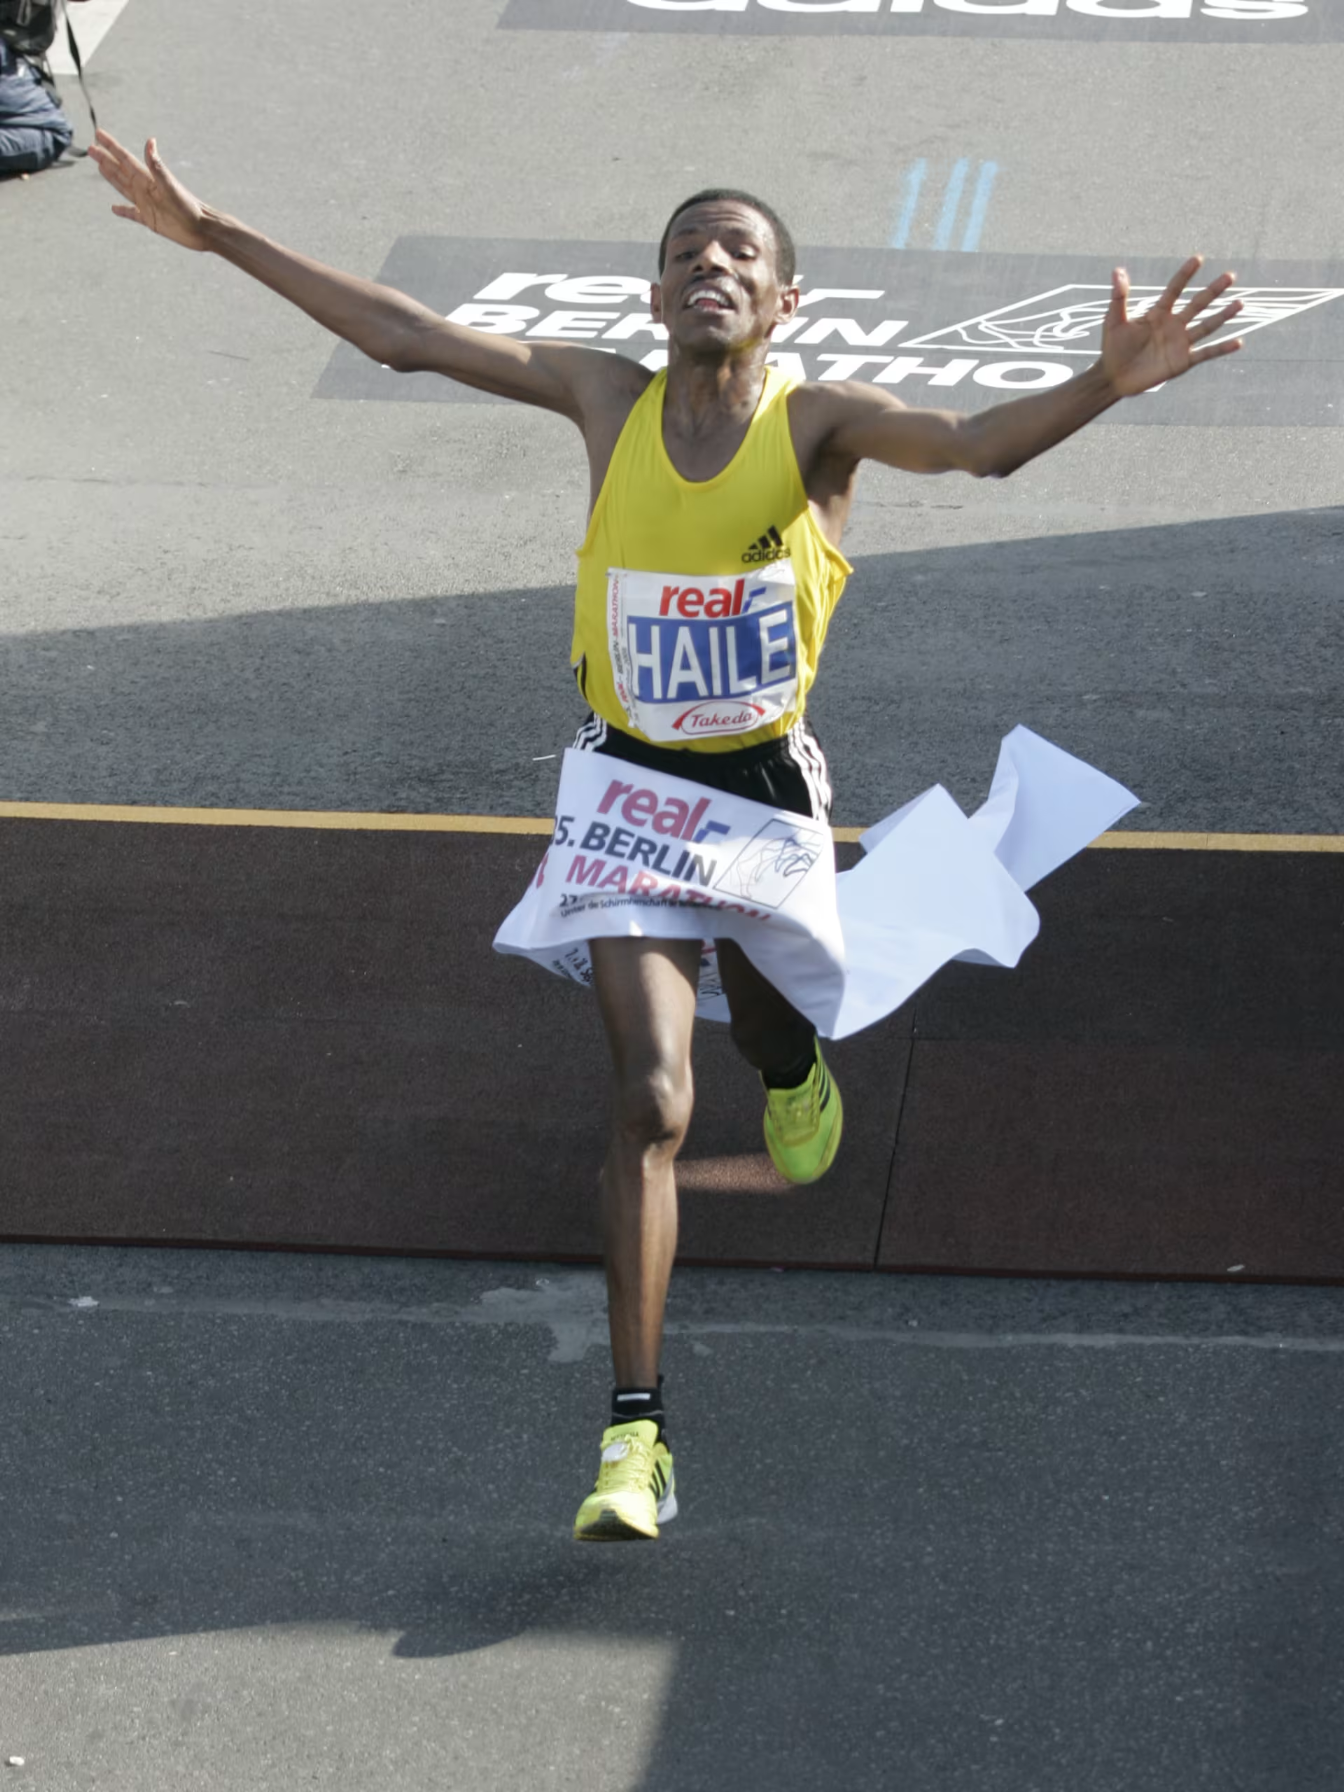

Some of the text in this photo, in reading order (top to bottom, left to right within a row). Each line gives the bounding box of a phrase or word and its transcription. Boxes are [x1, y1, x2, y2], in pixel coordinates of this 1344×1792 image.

[628, 609, 792, 699] HAILE
[691, 710, 754, 727] Takeda
[550, 815, 718, 887] 5. BERLIN
